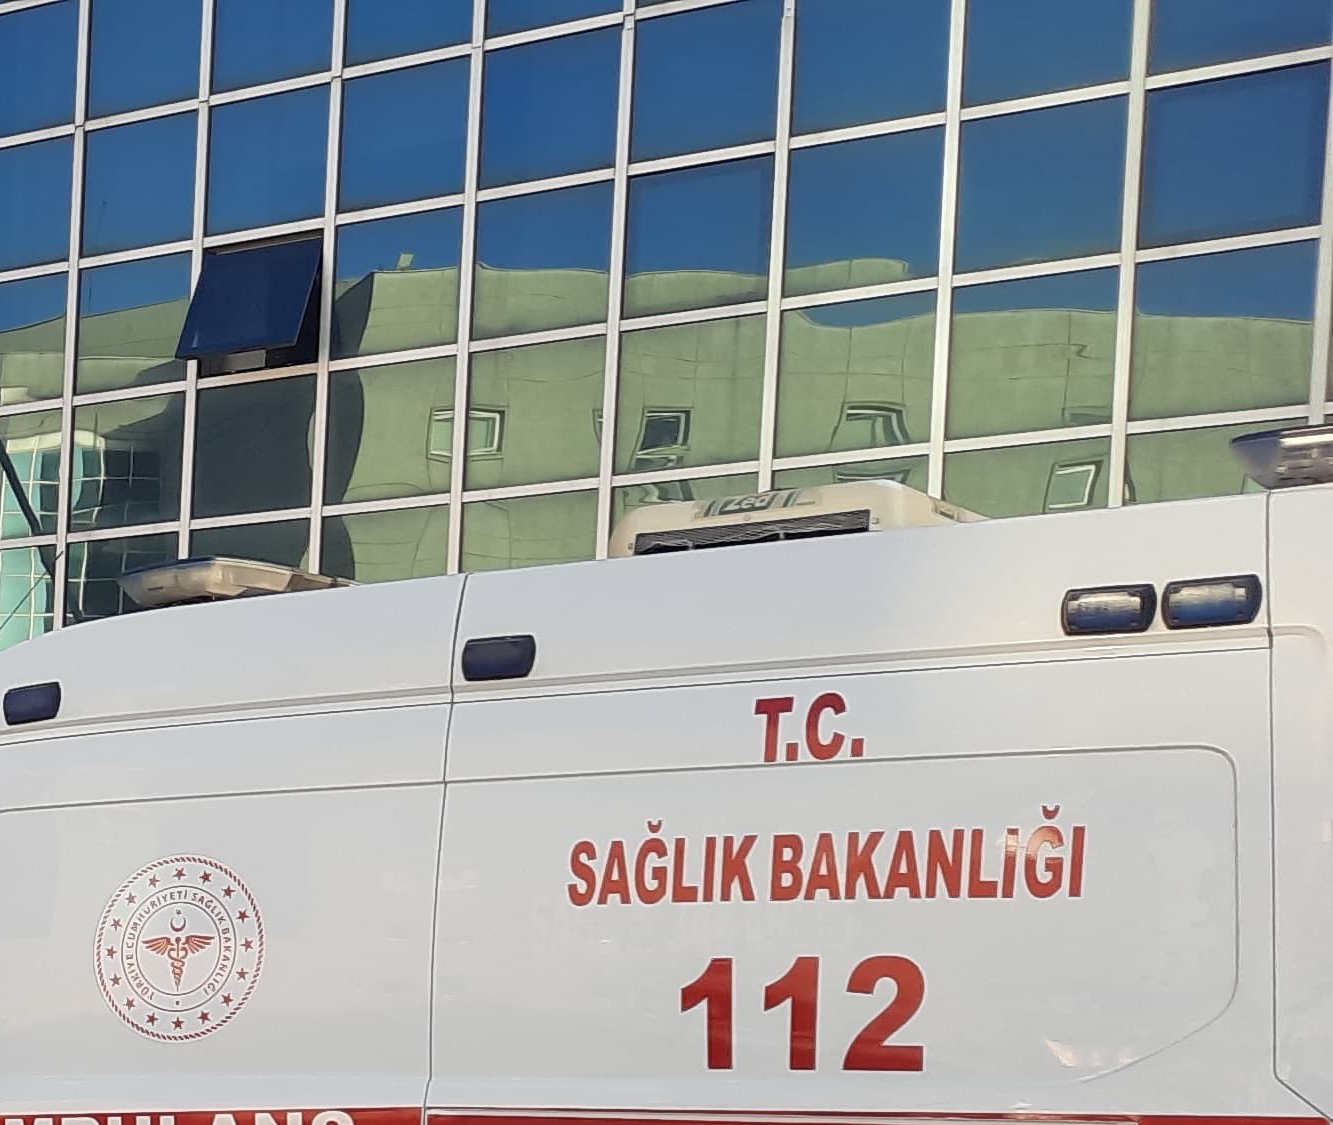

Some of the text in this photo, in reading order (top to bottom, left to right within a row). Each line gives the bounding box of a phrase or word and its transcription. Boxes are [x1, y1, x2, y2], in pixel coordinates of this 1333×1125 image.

[754, 692, 865, 763] T.C.
[567, 804, 1086, 907] SAĞLIK BAKANLIĞI
[679, 956, 926, 1072] 112
